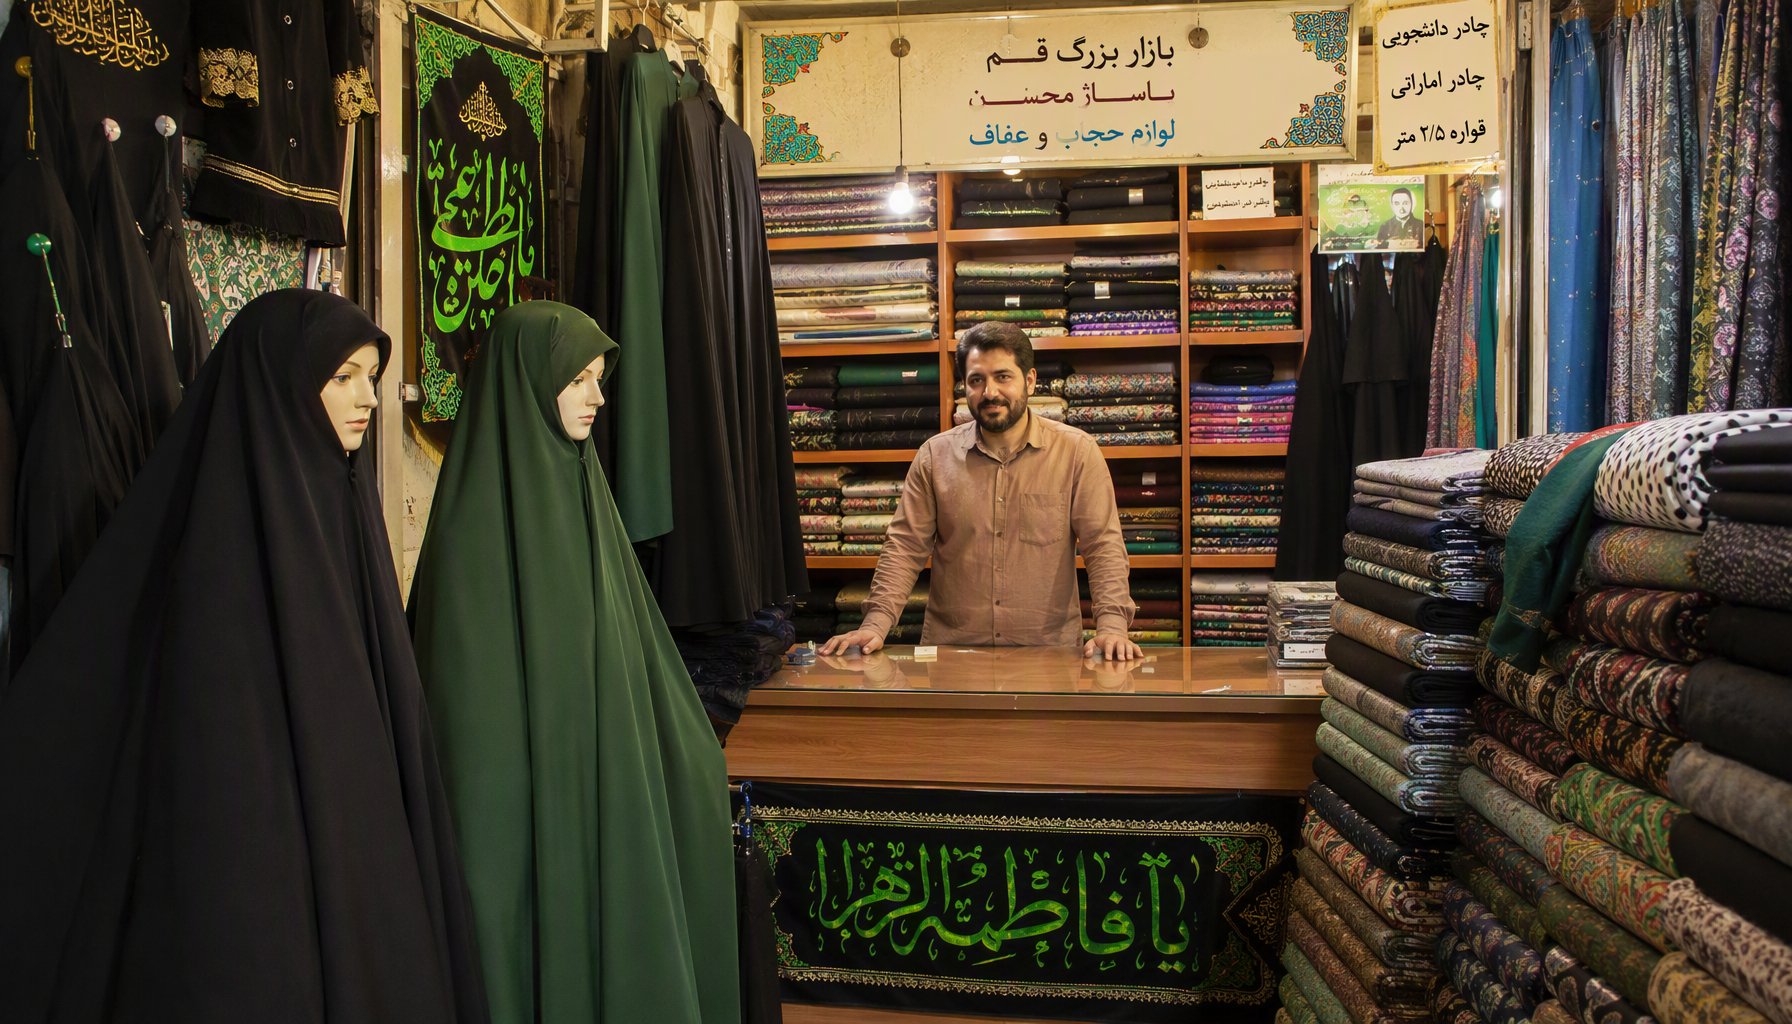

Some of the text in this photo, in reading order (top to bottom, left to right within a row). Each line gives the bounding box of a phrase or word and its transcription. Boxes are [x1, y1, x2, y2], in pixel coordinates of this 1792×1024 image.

[1382, 15, 1490, 49] چادر دانشجویی
[986, 35, 1175, 73] بازار بزرگ قم
[1391, 67, 1485, 99] چادر اماراتی
[969, 118, 1175, 151] لوازم حجاب و عفاف
[1392, 131, 1416, 151] متر
[1450, 119, 1487, 144] قواره
